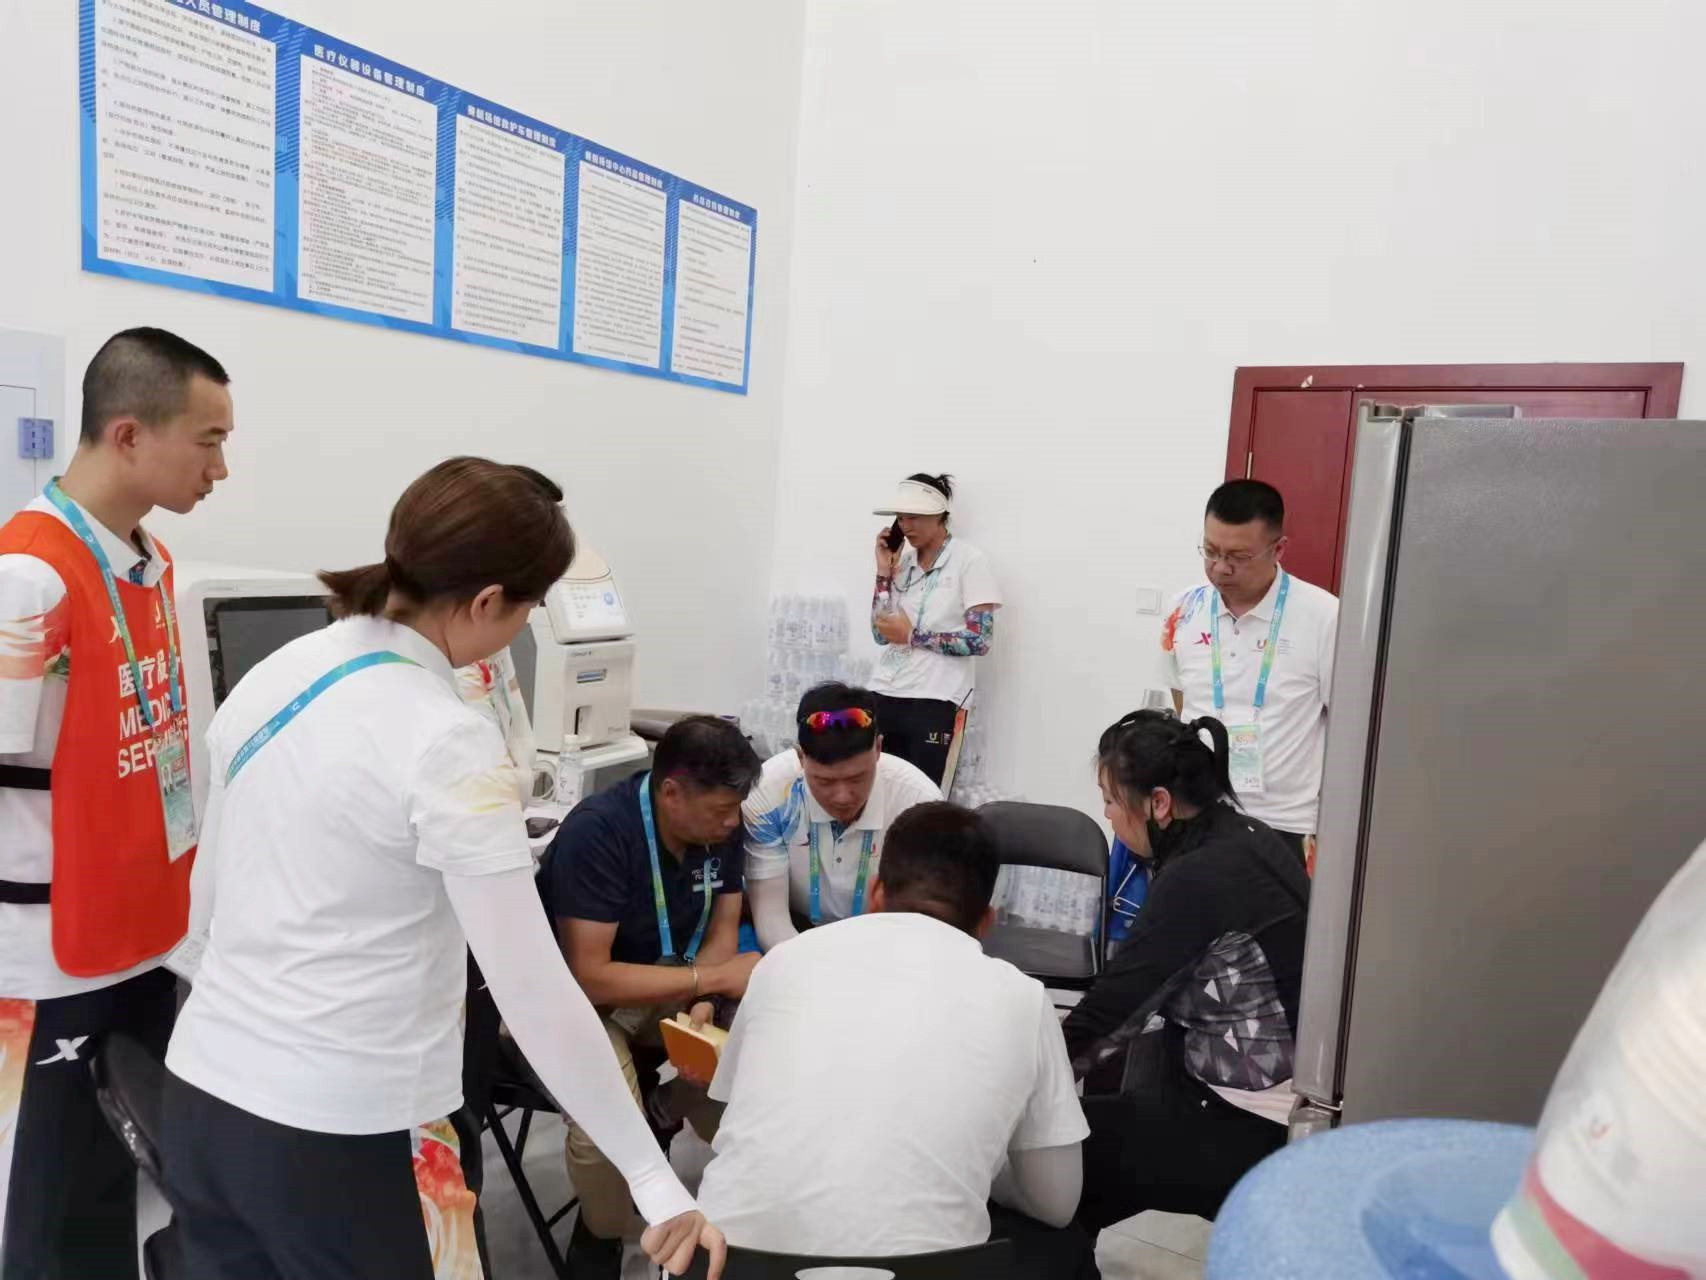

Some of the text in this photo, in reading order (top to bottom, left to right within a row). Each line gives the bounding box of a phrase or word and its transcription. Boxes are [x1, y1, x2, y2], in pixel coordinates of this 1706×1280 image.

[176, 0, 261, 33] 人员管理制度
[313, 43, 425, 98] 医疗仪器设备管理制度
[119, 685, 187, 741] MEDICL
